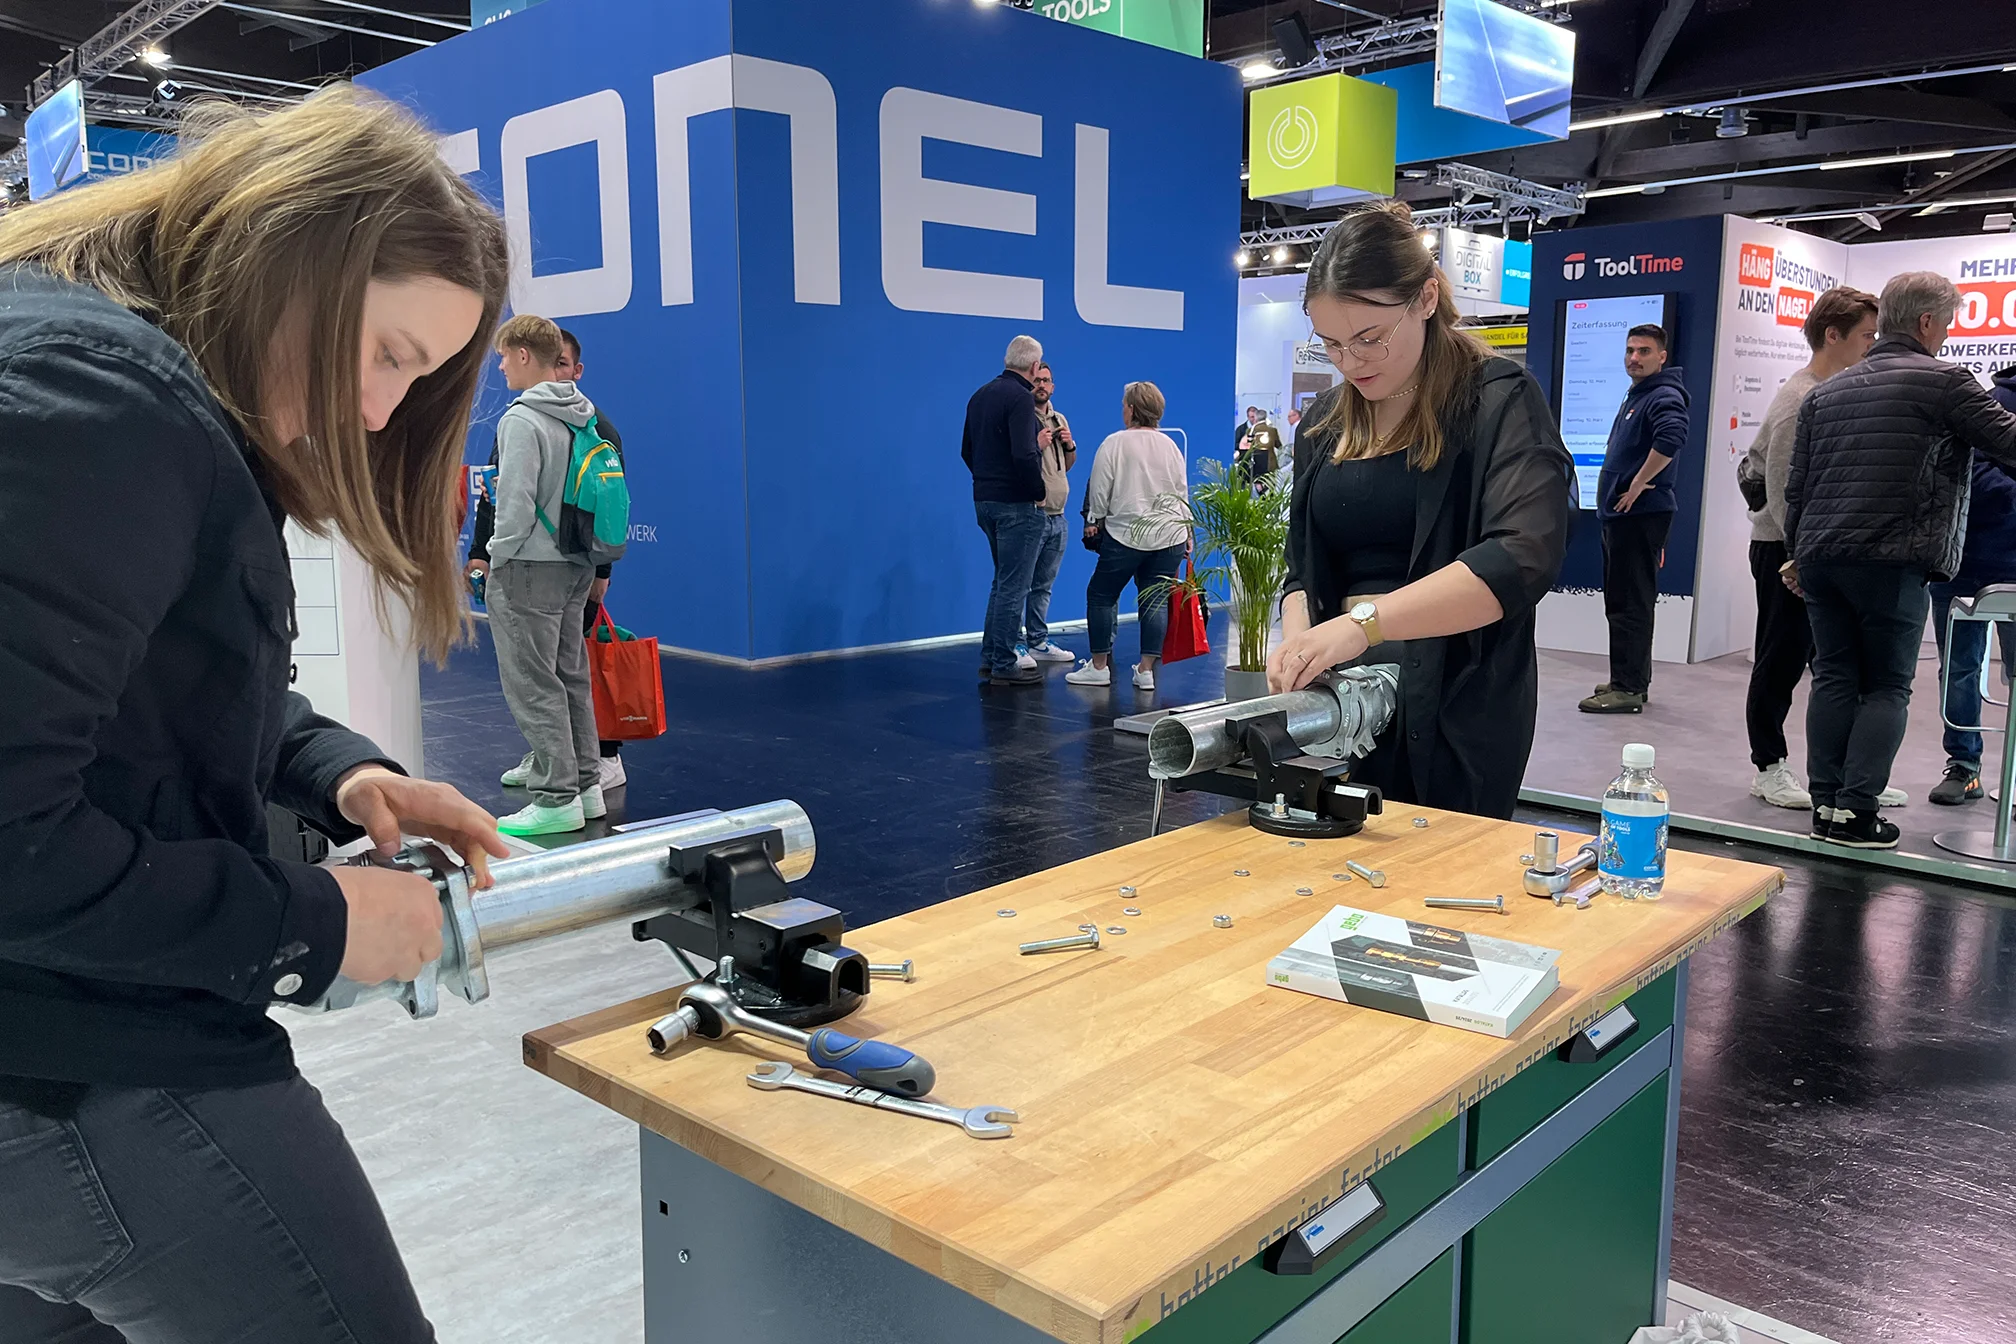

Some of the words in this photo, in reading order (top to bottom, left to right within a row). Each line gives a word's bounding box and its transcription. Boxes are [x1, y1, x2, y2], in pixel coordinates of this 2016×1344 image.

[440, 53, 1184, 331] ONEL
[1456, 250, 1492, 271] DIGITAL
[1594, 254, 1683, 277] ToolTime
[1742, 249, 1771, 280] HÄNG
[1464, 270, 1481, 284] BOX
[1738, 289, 1754, 312] AN
[1755, 292, 1775, 314] DEN
[1571, 320, 1628, 330] Zeiterfassung
